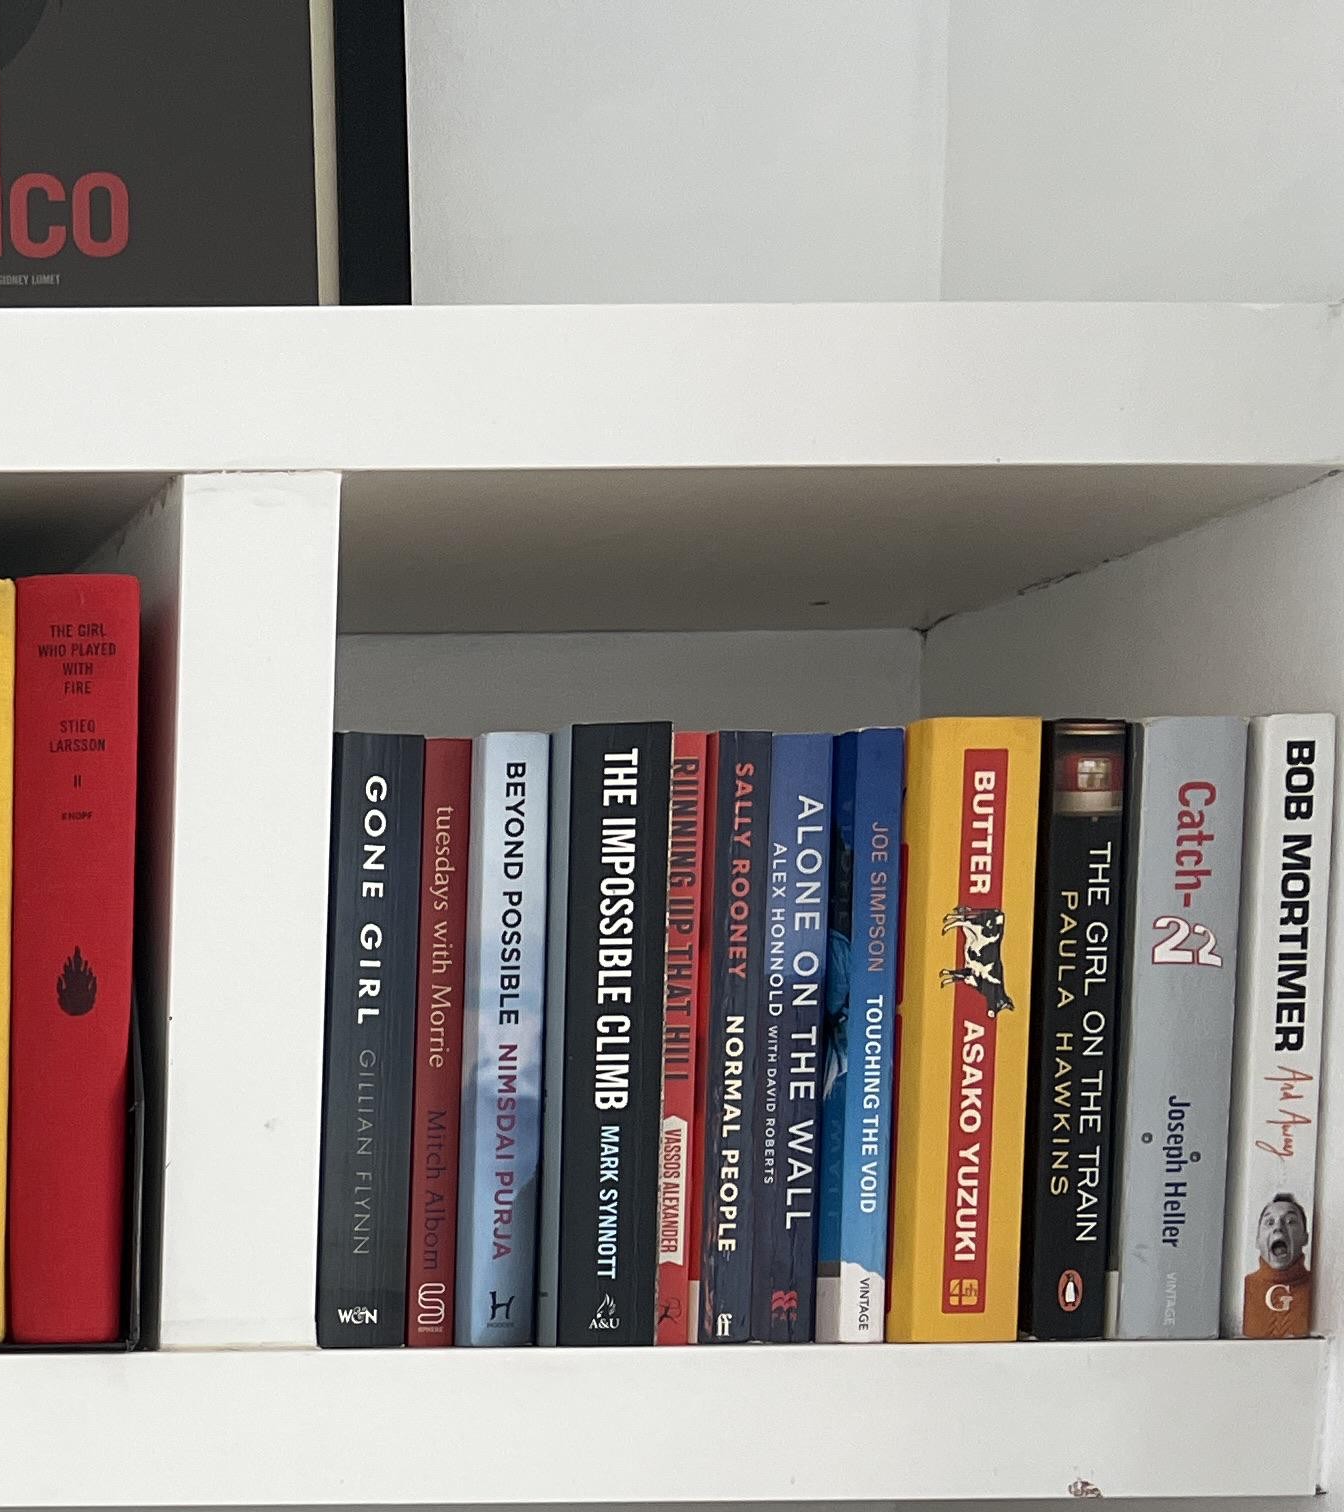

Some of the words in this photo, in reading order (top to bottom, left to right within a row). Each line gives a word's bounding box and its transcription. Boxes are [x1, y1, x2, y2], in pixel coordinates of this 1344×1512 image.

[969, 772, 996, 895] BUTTER
[1284, 740, 1316, 820] BOB
[362, 775, 388, 899] GONE
[794, 795, 823, 932] ALONE
[357, 923, 382, 1025] GIRL
[792, 950, 818, 1008] ON
[1273, 833, 1313, 1053] MORTIMER
[720, 1015, 744, 1139] NORMAL
[789, 1027, 817, 1101] THE
[864, 995, 884, 1111] TOUCHING
[960, 1018, 986, 1134] ASAKO
[785, 1120, 813, 1230] WALL
[860, 1159, 877, 1214] VOID
[861, 1115, 880, 1155] THE
[717, 1148, 739, 1253] PEOPLE
[953, 1144, 980, 1261] YUZUKI
[858, 1277, 869, 1332] VINTAGE
